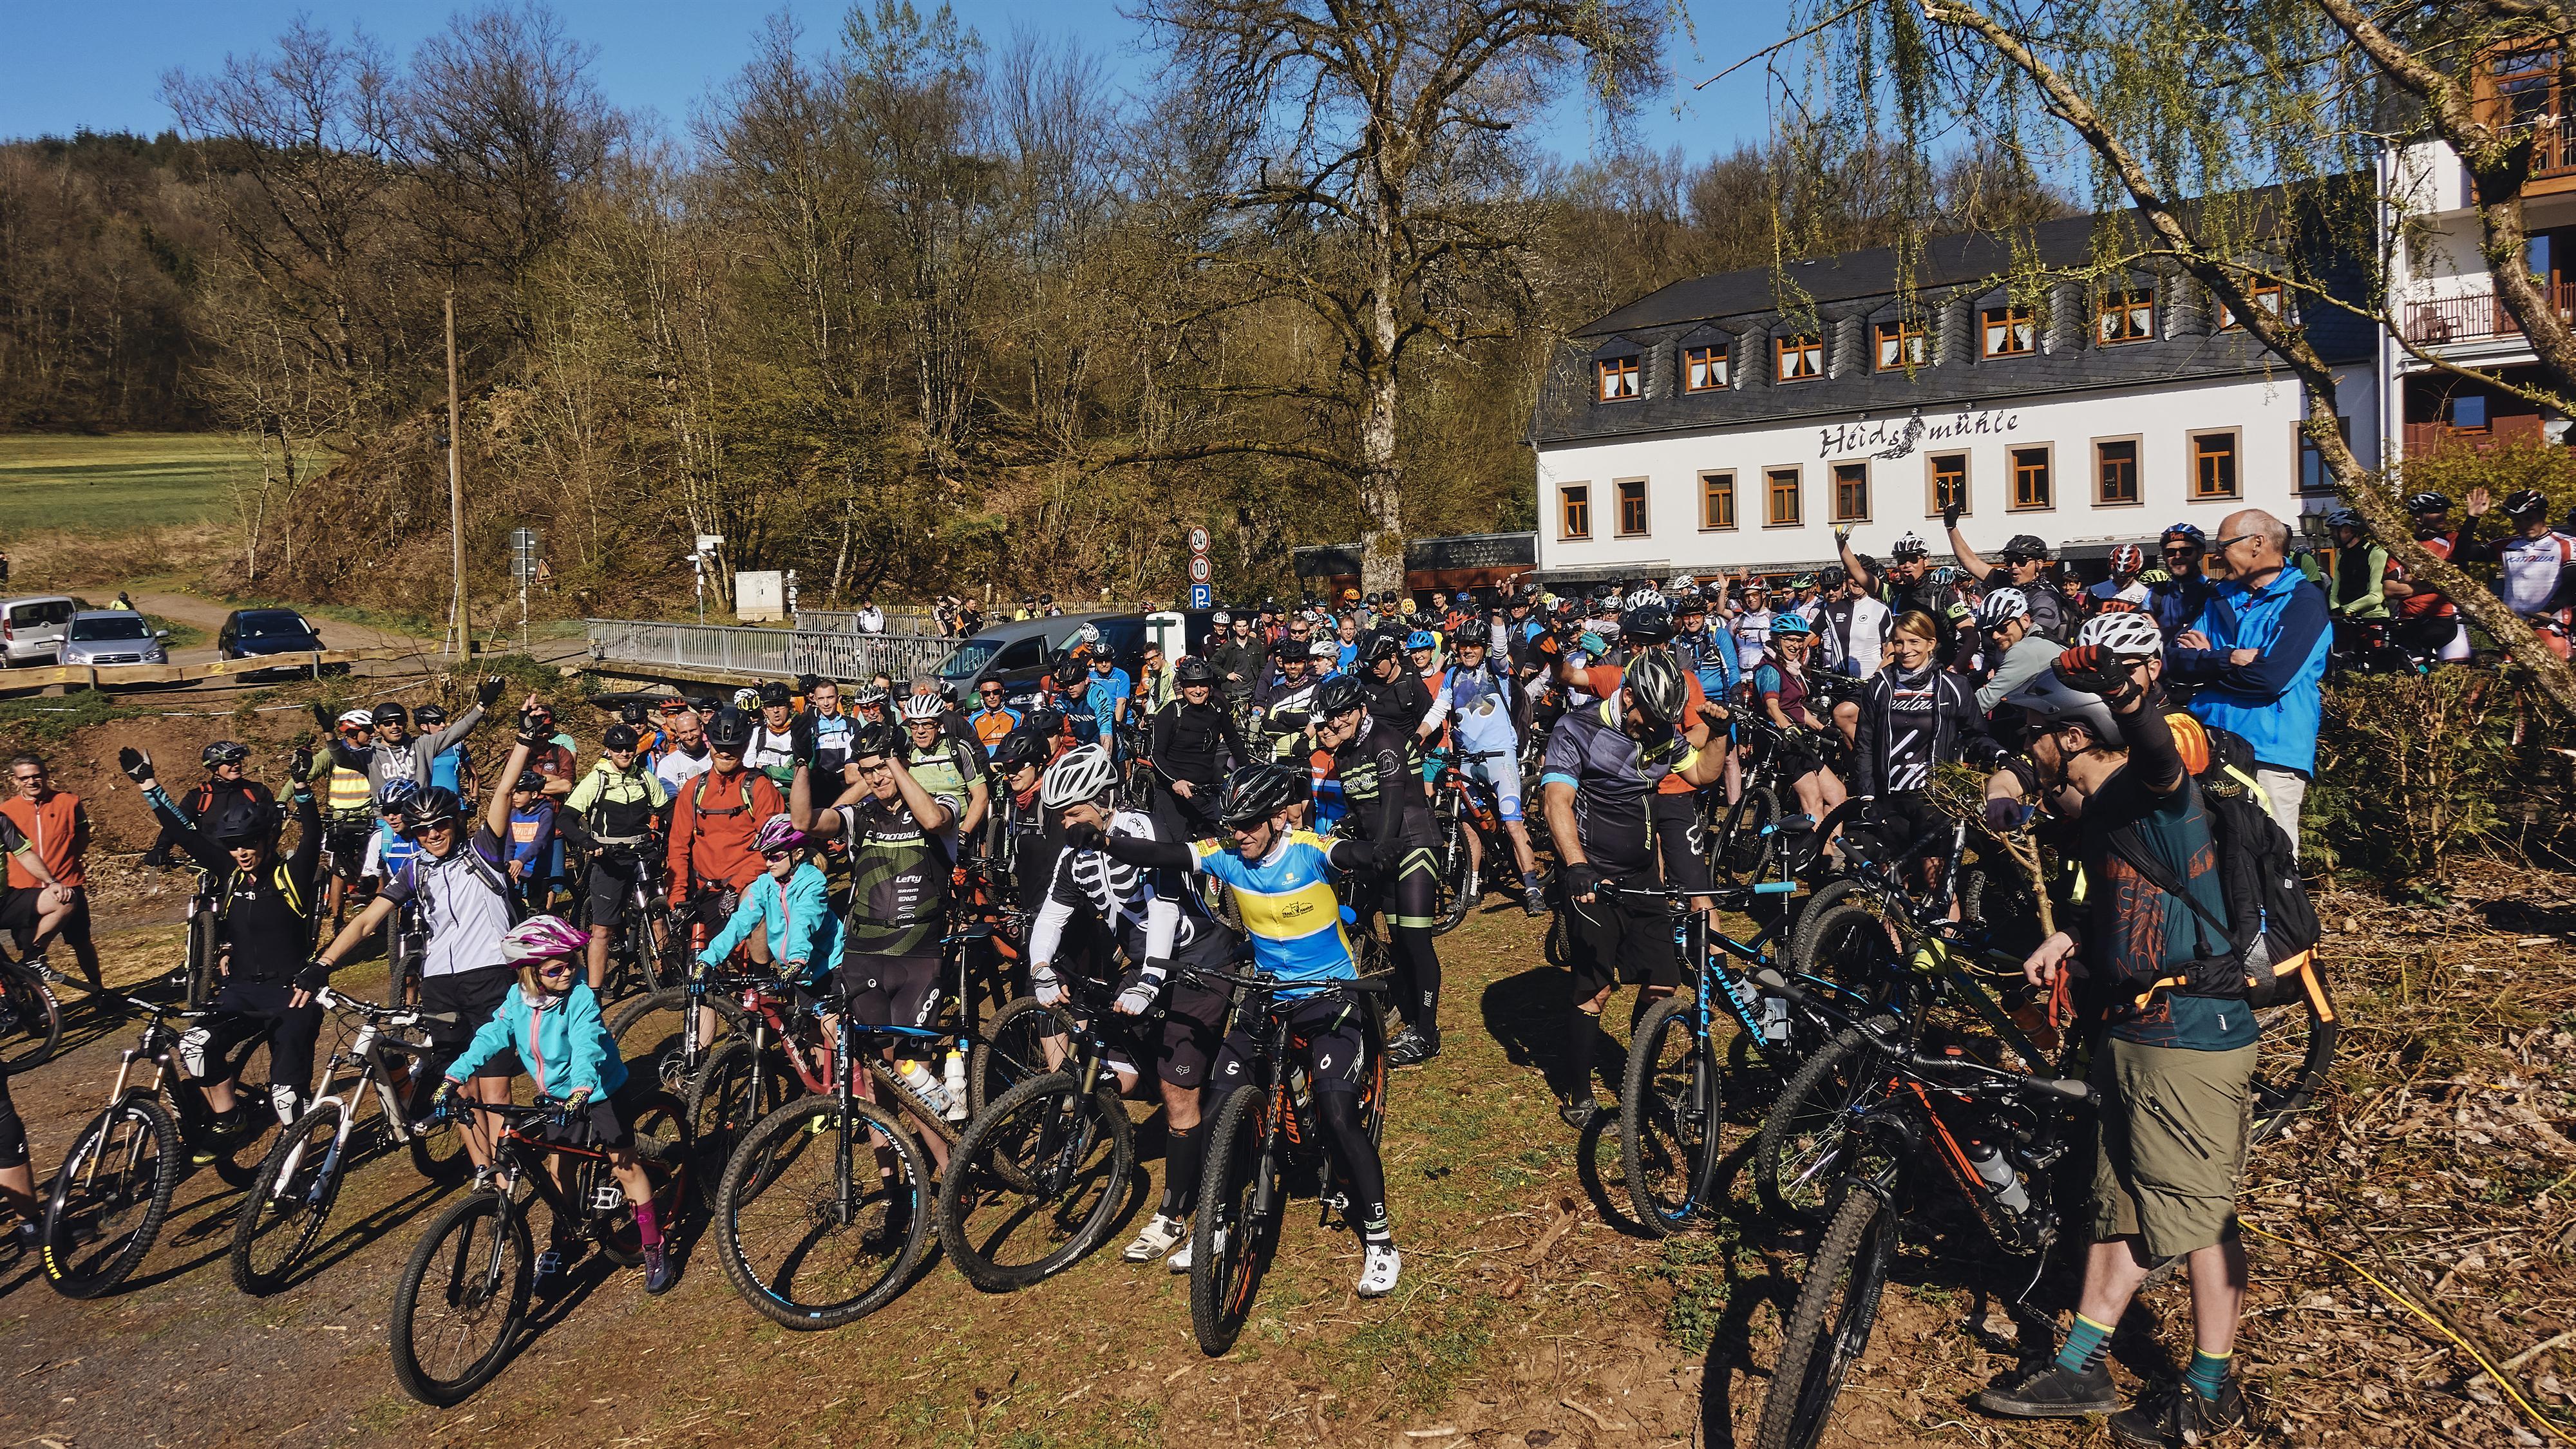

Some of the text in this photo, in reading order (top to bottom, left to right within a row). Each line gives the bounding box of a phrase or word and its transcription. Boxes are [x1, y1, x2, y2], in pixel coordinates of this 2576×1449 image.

[1195, 563, 1206, 576] 10
[1195, 588, 1206, 609] P
[52, 667, 66, 681] 3
[210, 664, 225, 674] 2
[865, 829, 920, 840] CNNONDALE
[896, 875, 922, 884] Lefty
[1423, 990, 1434, 1007] ROSE
[1698, 974, 1710, 1037] Lefty
[904, 1161, 916, 1186] ZTR
[43, 1245, 62, 1280] MAXXIS
[822, 1277, 896, 1318] SCHWALBE
